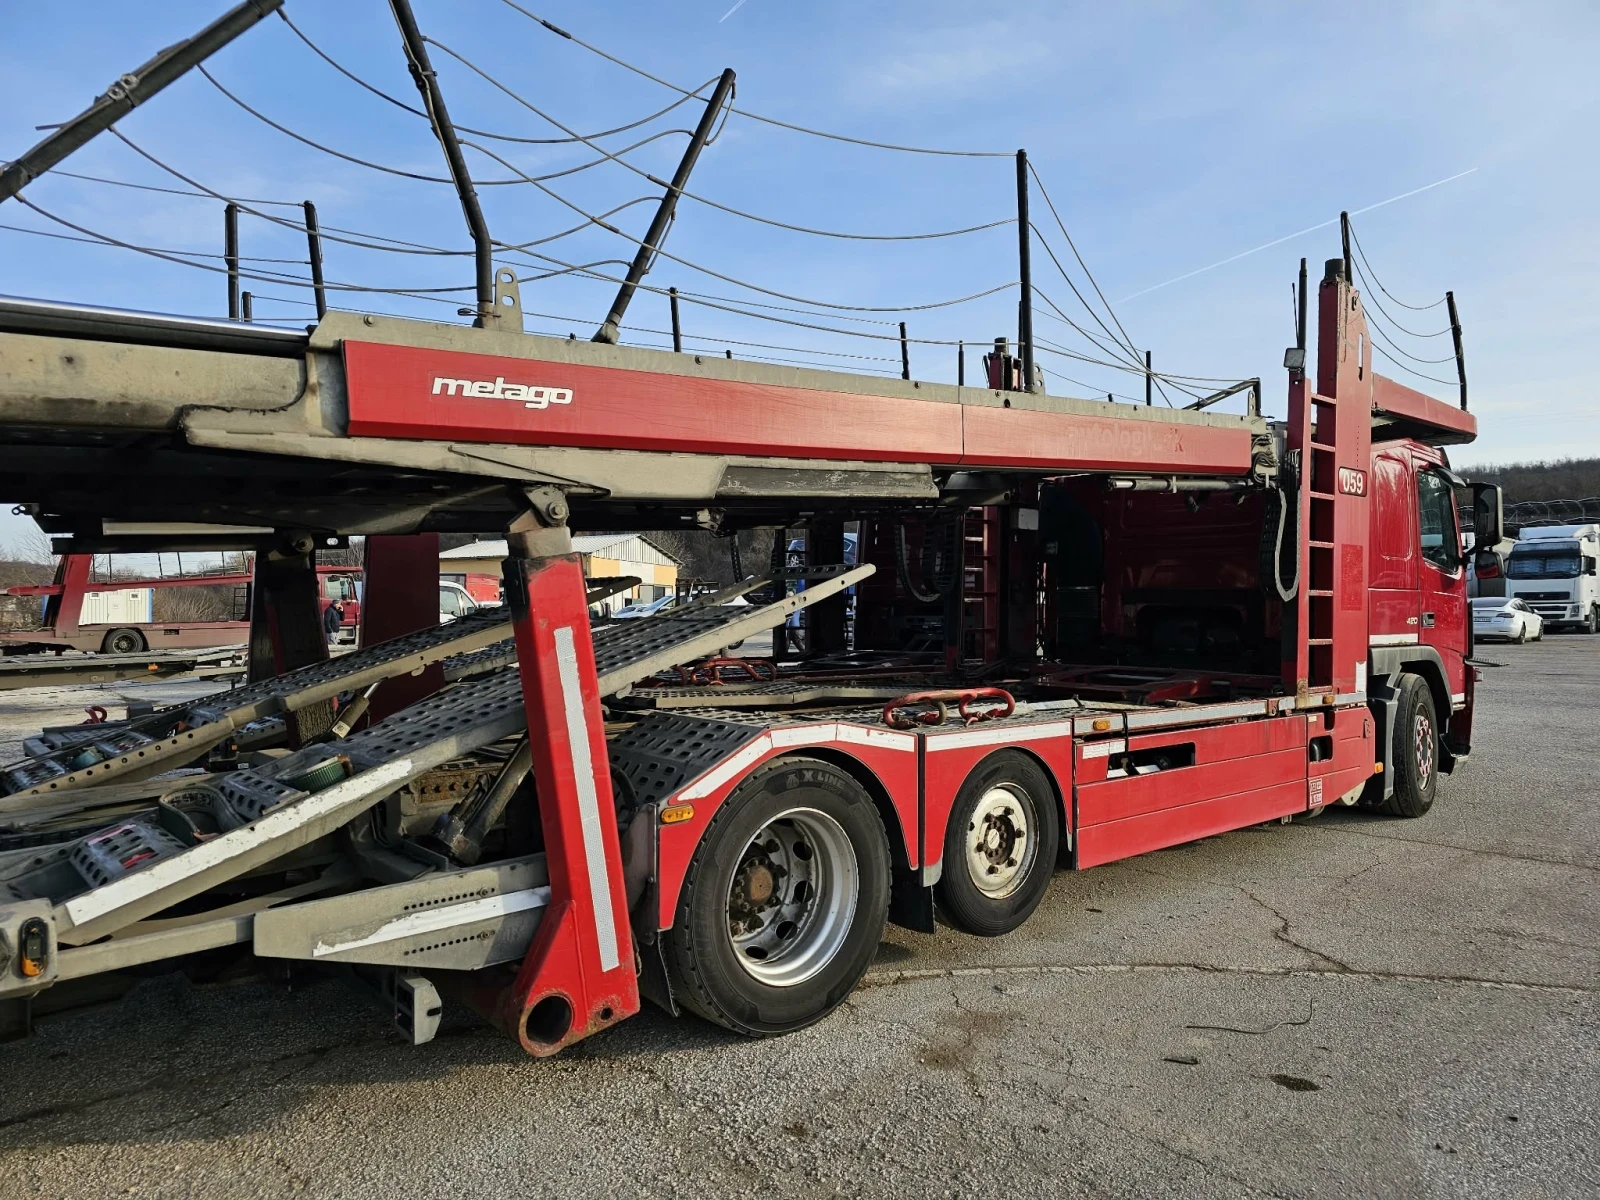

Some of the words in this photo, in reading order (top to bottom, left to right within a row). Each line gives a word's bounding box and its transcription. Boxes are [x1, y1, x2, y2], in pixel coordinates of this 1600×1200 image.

[432, 376, 573, 409] metago
[1342, 470, 1364, 495] 059
[802, 769, 814, 782] X
[817, 769, 846, 791] LINE
